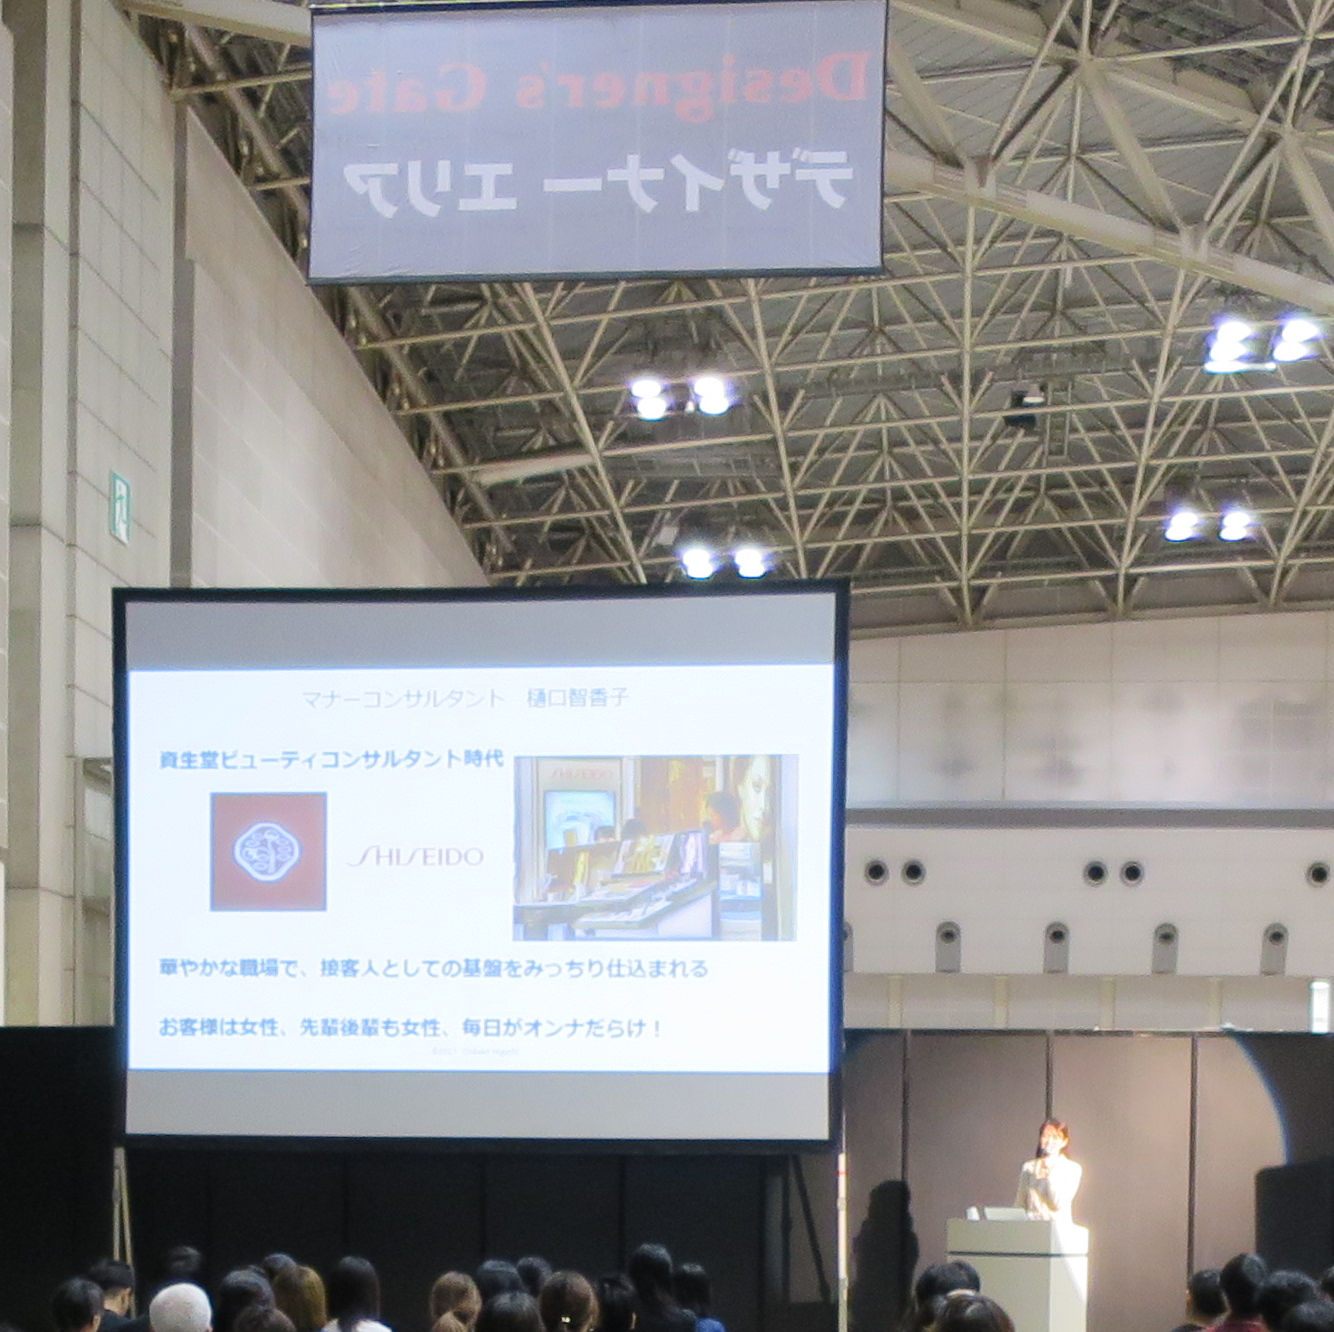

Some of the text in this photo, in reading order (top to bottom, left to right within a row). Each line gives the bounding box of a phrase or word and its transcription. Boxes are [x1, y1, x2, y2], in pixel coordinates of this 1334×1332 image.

[302, 690, 505, 710] マナーコンサルタント
[159, 749, 505, 770] 資生堂ビューティコンサルタント時代
[347, 845, 484, 868] SHISEIDO
